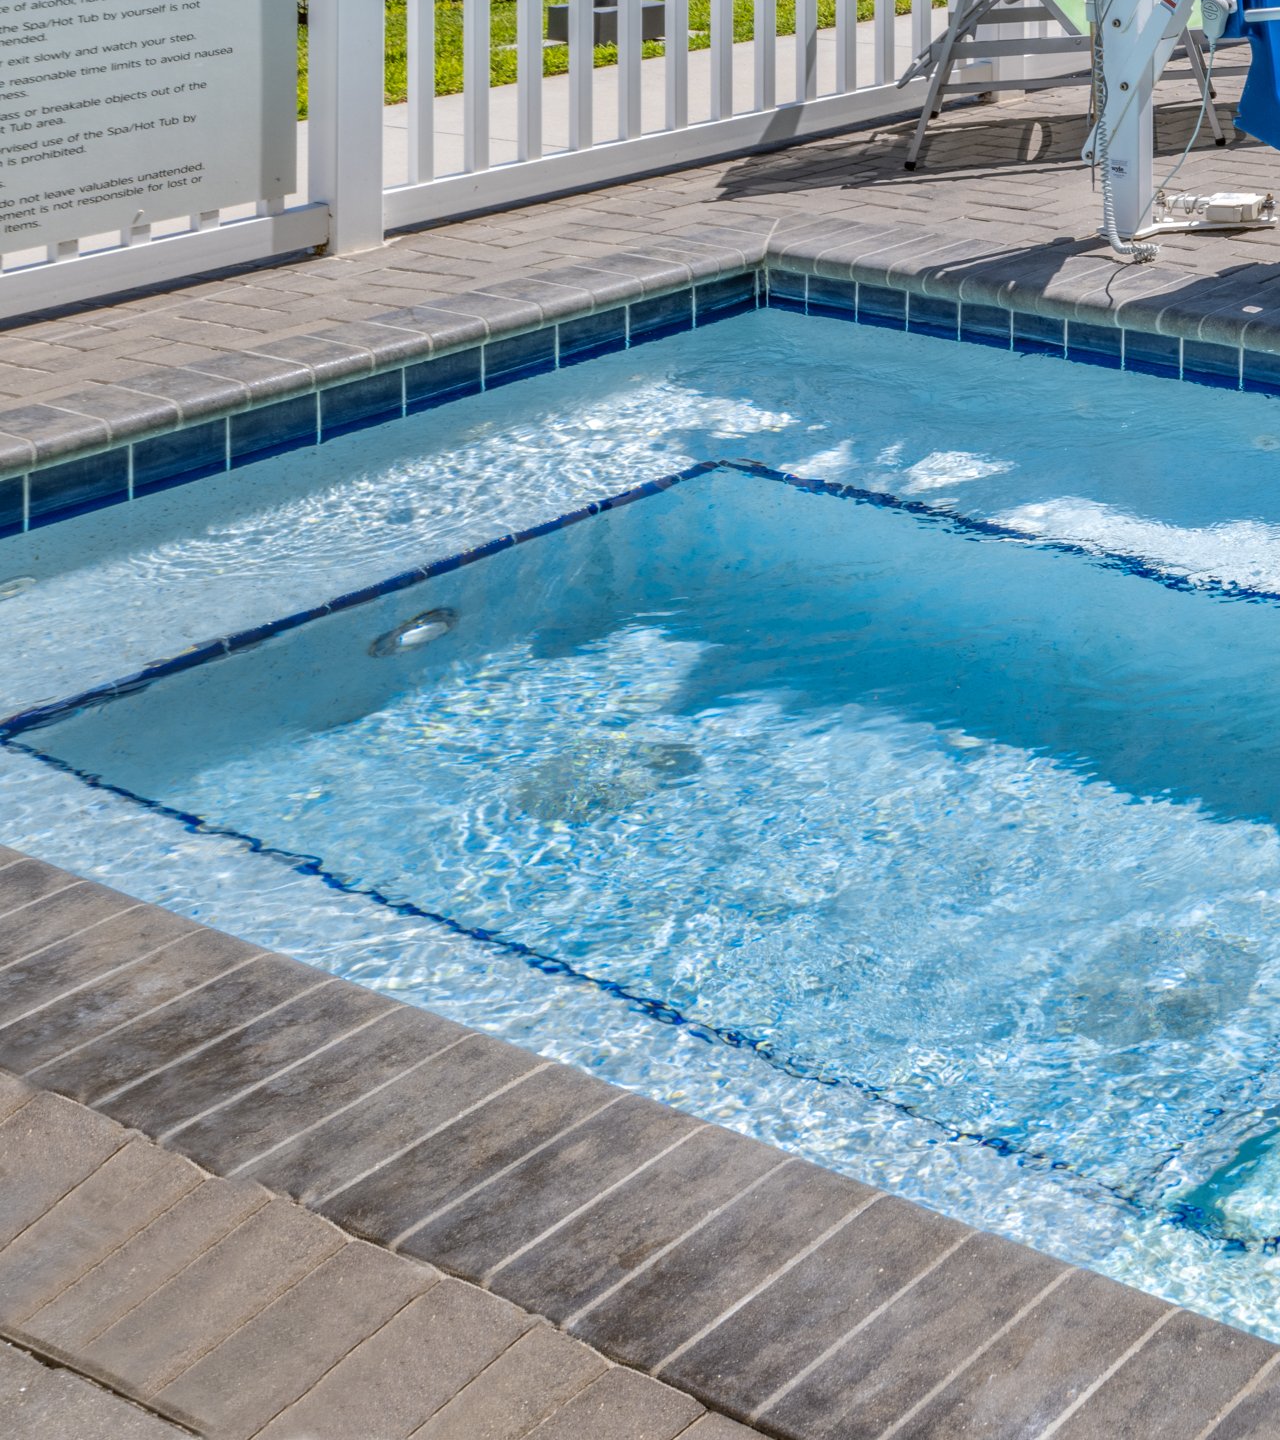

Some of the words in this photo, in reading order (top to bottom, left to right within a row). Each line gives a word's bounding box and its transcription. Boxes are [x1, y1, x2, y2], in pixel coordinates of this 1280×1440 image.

[14, 2, 26, 12] of
[22, 17, 73, 31] Spa/Hot
[78, 14, 99, 23] Tub
[103, 12, 117, 21] by
[121, 4, 166, 19] yourself
[169, 3, 178, 12] is
[182, 0, 201, 10] not
[7, 56, 30, 66] exit
[34, 51, 71, 63] slowly
[75, 46, 98, 57] and
[102, 41, 138, 52] watch
[141, 37, 166, 49] your
[170, 33, 197, 44] step.
[9, 70, 77, 87] reasonable
[80, 65, 107, 75] time
[111, 60, 142, 71] limits
[145, 58, 157, 66] to
[160, 52, 191, 64] avoid
[194, 46, 233, 58] nausea
[24, 109, 38, 117] or
[41, 98, 101, 114] breakable
[105, 91, 147, 103] objects
[151, 87, 170, 97] out
[173, 83, 186, 93] of
[188, 81, 207, 91] the
[9, 122, 32, 132] Tub
[36, 117, 67, 128] area.
[42, 137, 63, 147] use
[67, 133, 80, 143] of
[83, 130, 104, 140] the
[107, 121, 155, 136] Spa/Hot
[159, 117, 180, 127] Tub
[183, 114, 197, 123] by
[7, 158, 17, 166] is
[21, 145, 87, 165] prohibited.
[19, 194, 40, 204] not
[44, 188, 76, 200] leave
[79, 176, 134, 193] valuables
[137, 162, 205, 182] unattended.
[40, 205, 49, 213] is
[53, 200, 74, 211] not
[77, 186, 144, 206] responsible
[147, 183, 163, 192] for
[167, 178, 188, 188] lost
[191, 176, 202, 184] or
[4, 220, 42, 233] items.
